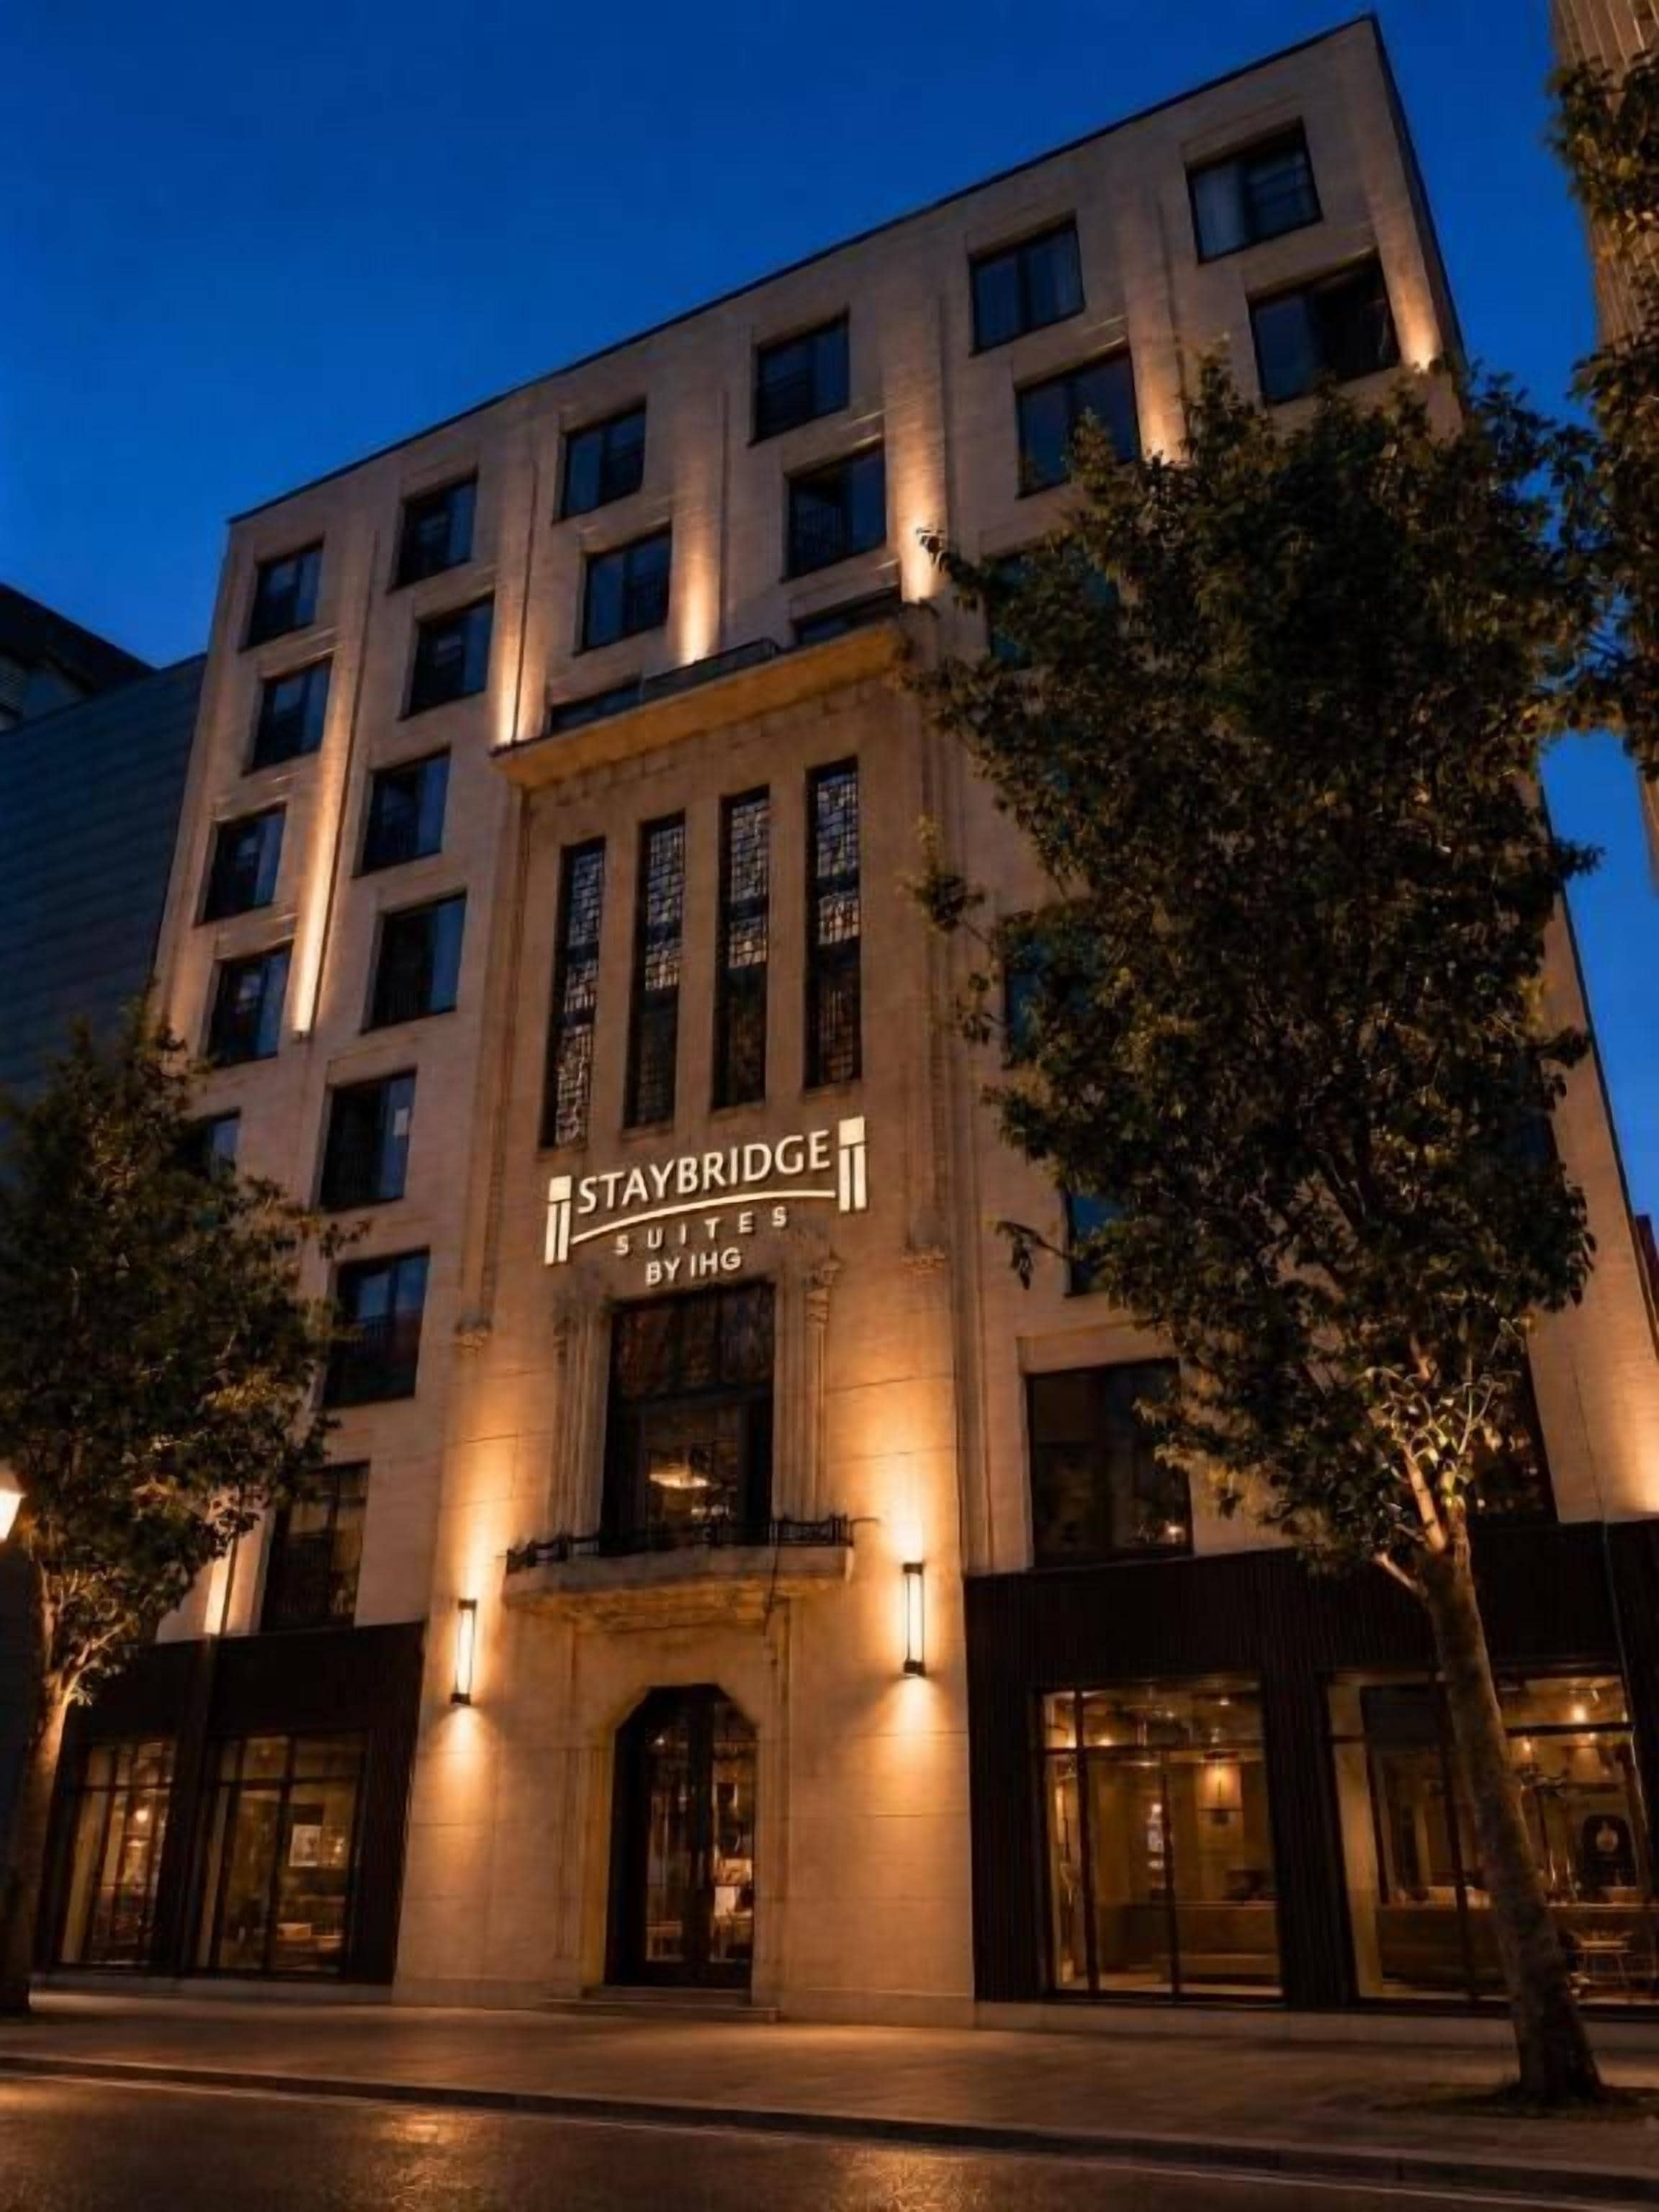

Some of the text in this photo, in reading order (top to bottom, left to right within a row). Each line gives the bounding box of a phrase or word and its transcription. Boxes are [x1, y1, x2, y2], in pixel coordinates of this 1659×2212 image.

[578, 1130, 831, 1214] STAYBRIDGE
[616, 1206, 787, 1256] SUITES
[646, 1247, 742, 1285] BY IHG
